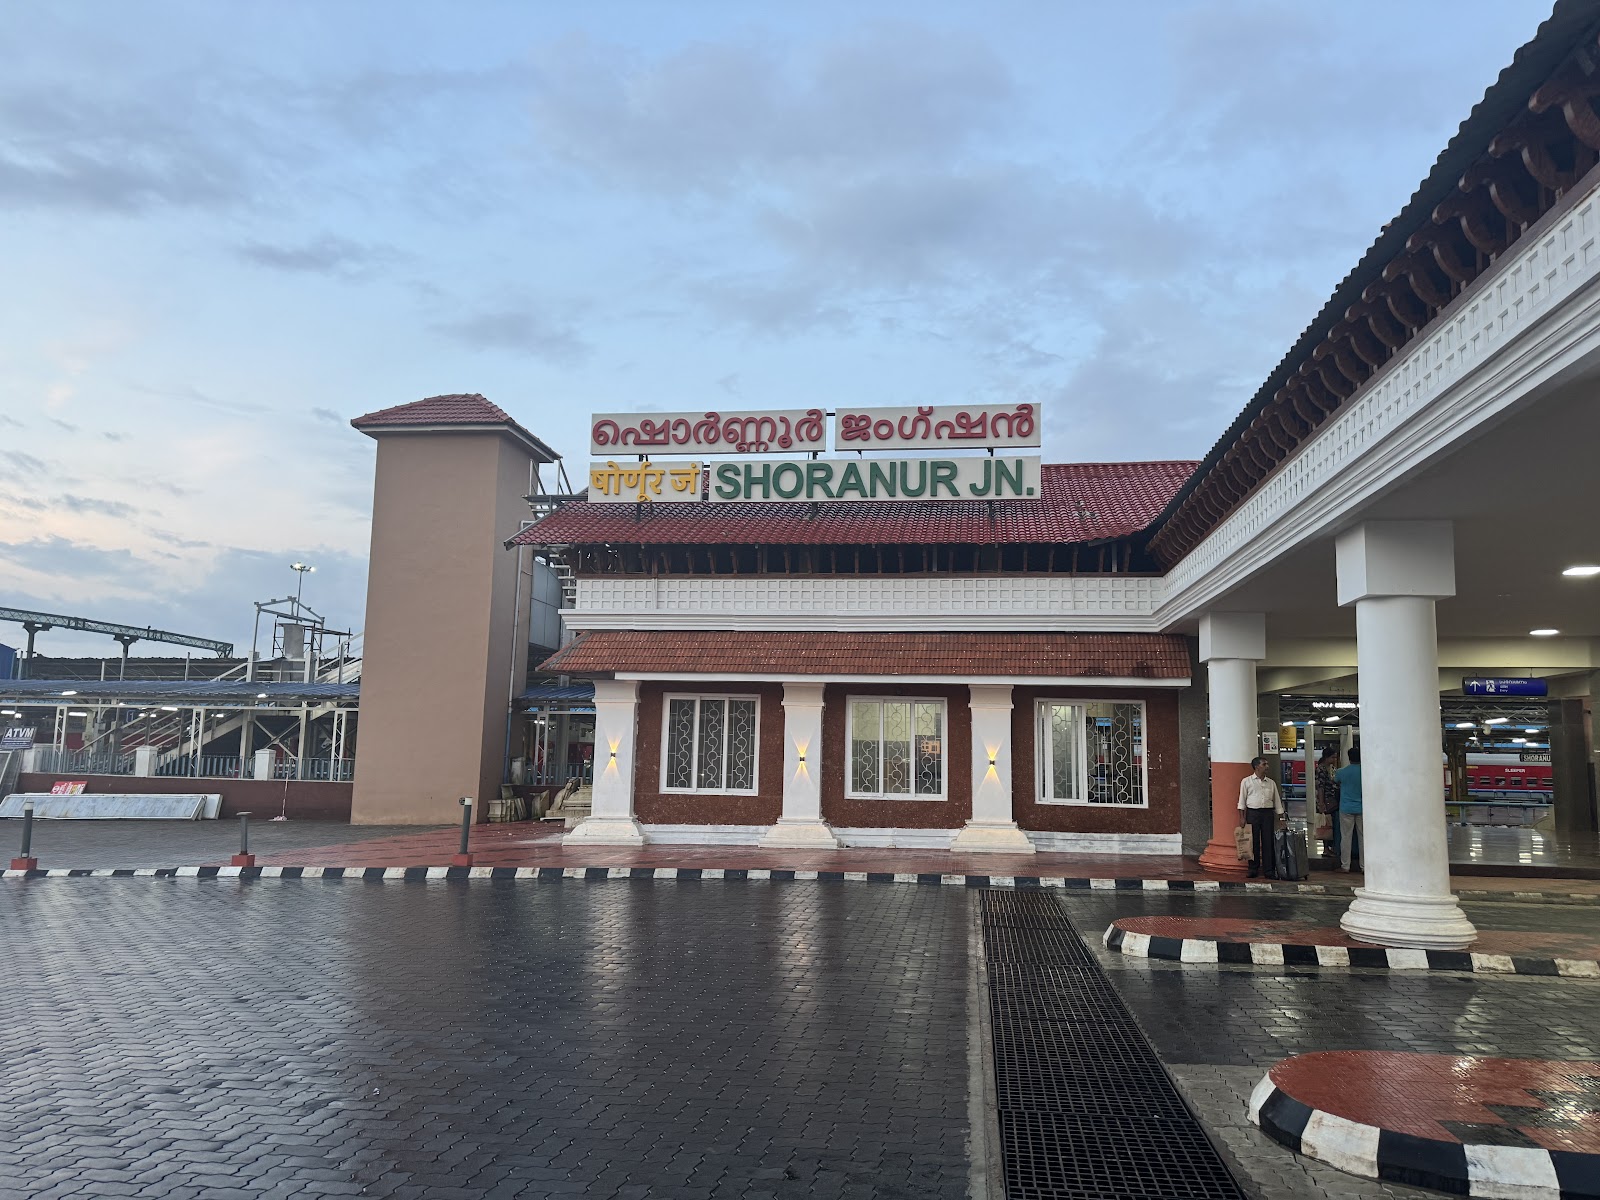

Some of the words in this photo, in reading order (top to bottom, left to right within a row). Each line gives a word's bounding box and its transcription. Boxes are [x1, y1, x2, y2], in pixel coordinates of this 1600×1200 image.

[841, 404, 1034, 442] ജംഗ്ഷൻ
[669, 462, 700, 495] जं
[714, 460, 960, 499] SHORANUR
[969, 459, 1035, 497] JN.
[5, 727, 35, 738] ATVM
[1523, 753, 1552, 762] SHORANU
